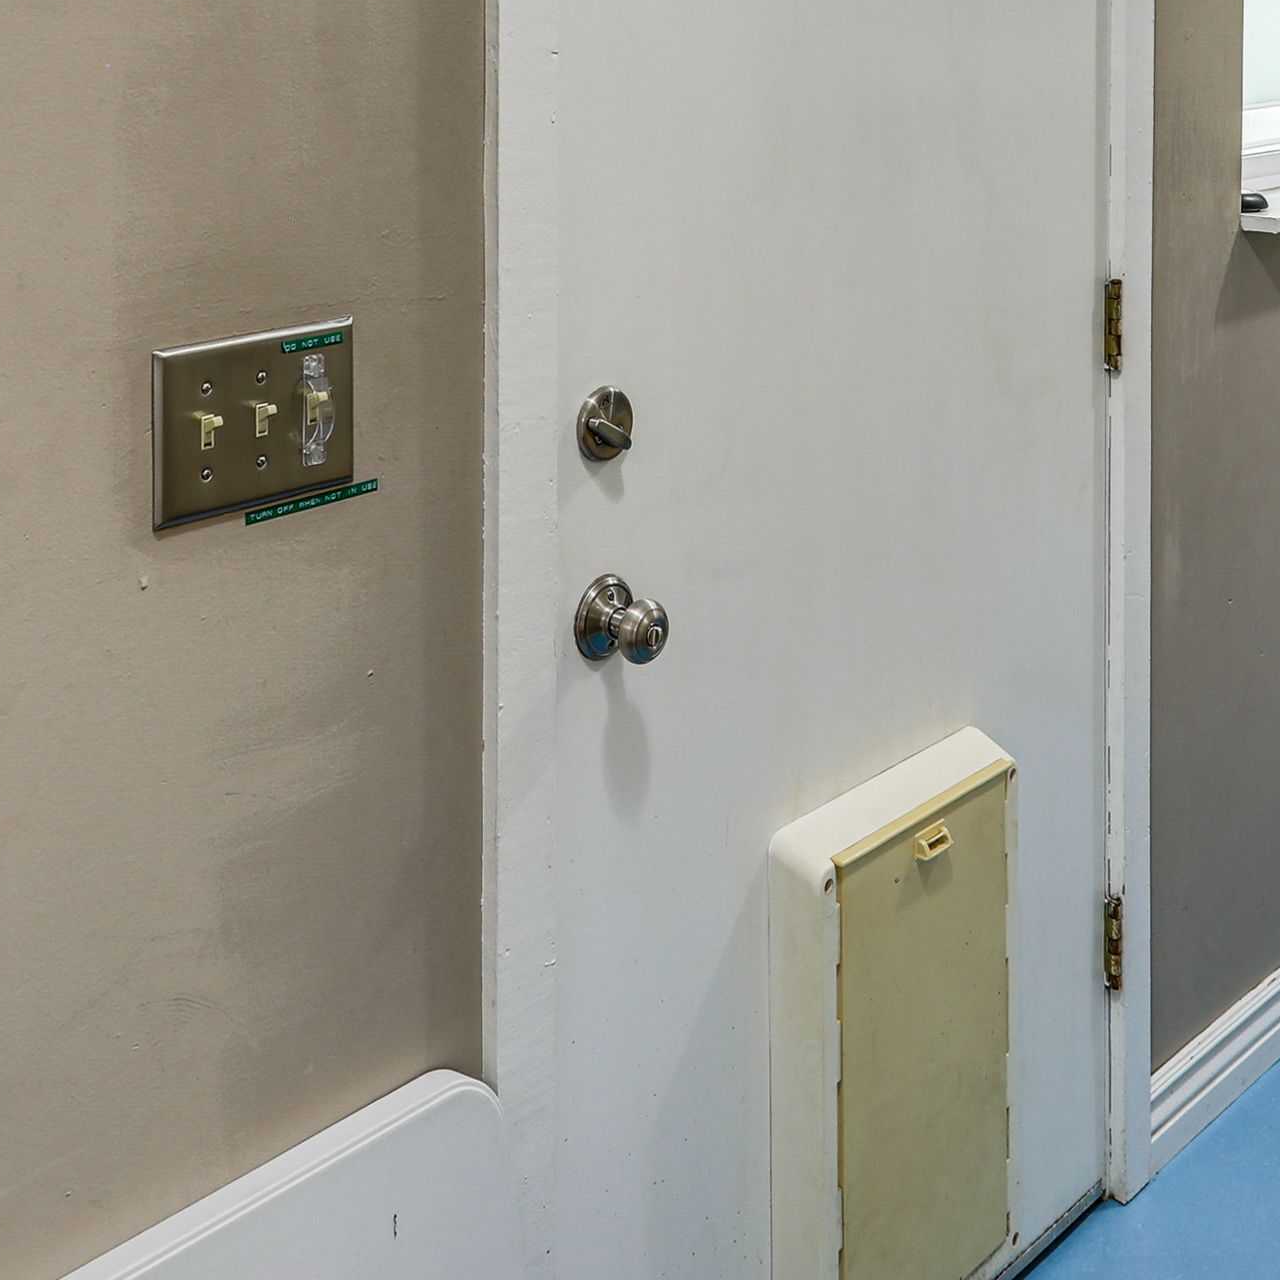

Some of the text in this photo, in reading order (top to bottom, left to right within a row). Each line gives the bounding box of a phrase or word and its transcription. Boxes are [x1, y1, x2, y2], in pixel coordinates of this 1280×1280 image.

[282, 334, 341, 353] DO NOT USE
[250, 509, 273, 521] TURN
[277, 505, 294, 515] OFF
[299, 498, 321, 509] WHEN
[324, 492, 341, 501] NOT
[361, 481, 377, 492] USE
